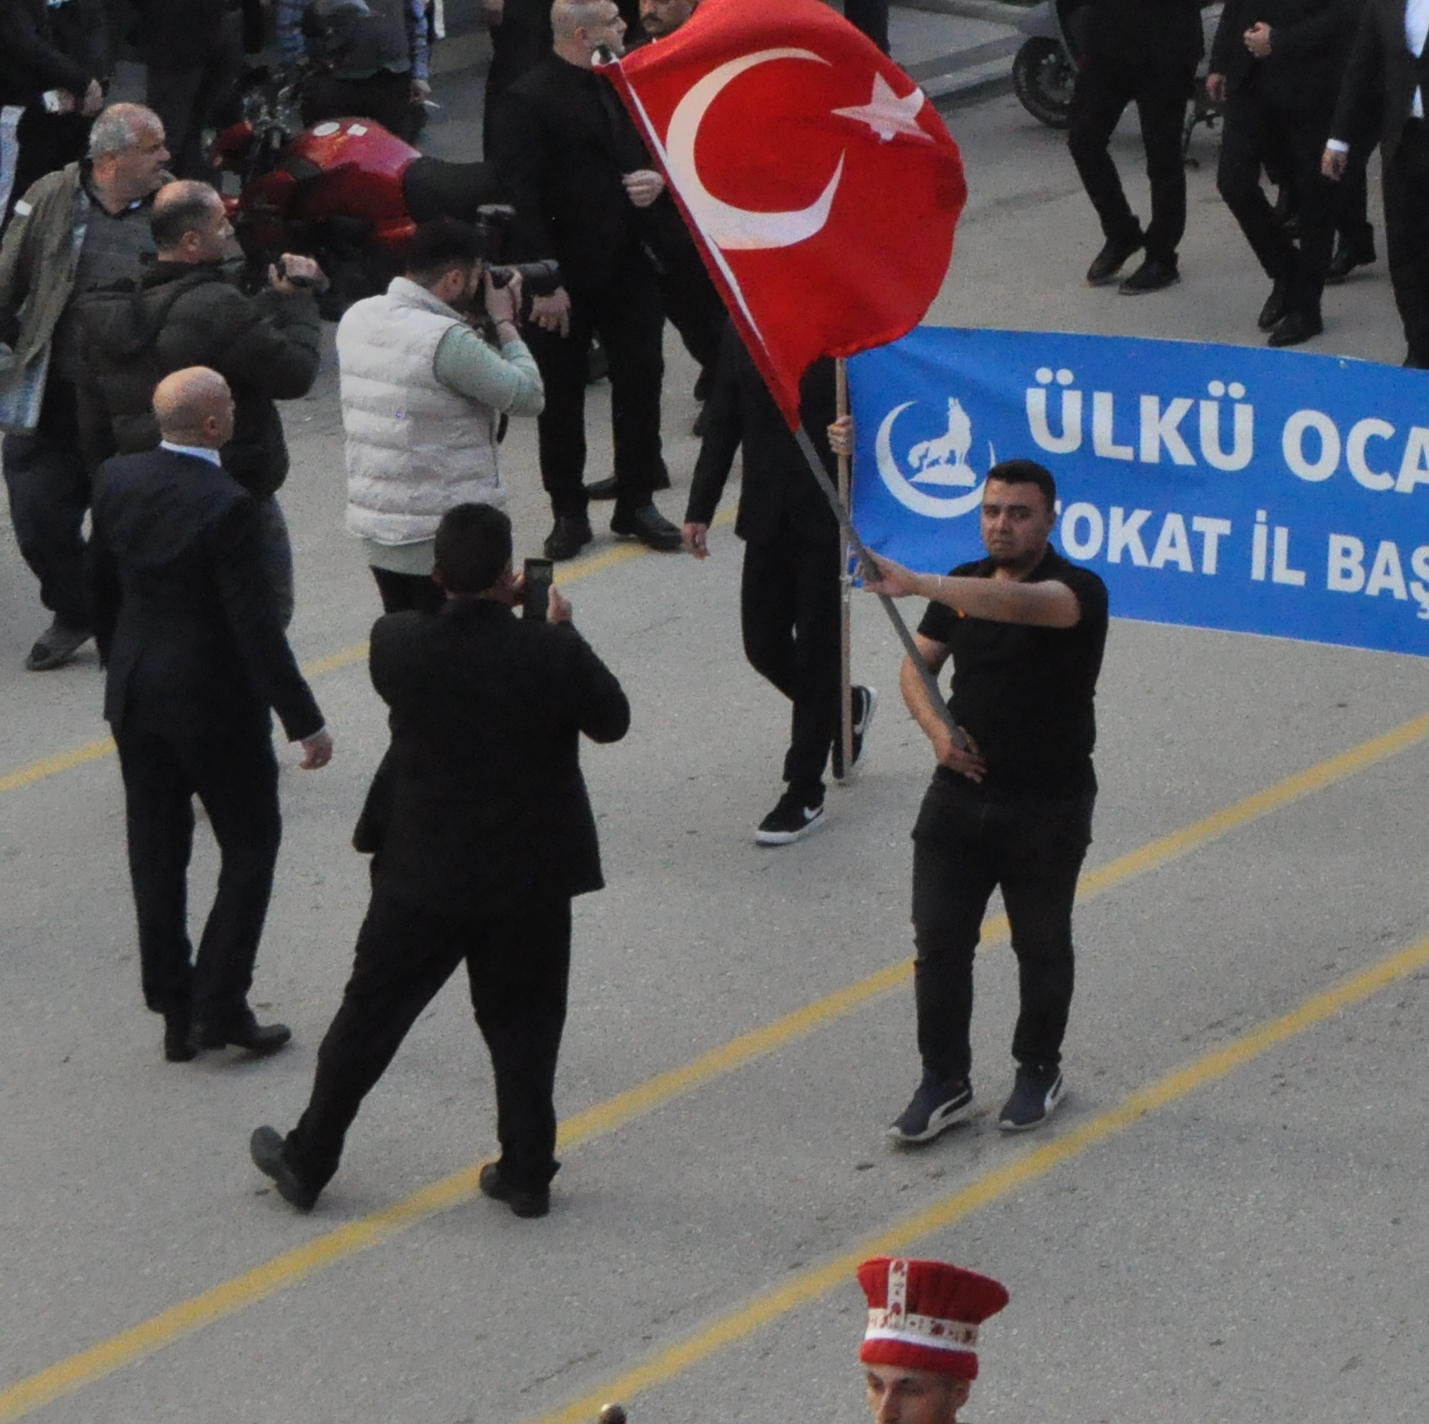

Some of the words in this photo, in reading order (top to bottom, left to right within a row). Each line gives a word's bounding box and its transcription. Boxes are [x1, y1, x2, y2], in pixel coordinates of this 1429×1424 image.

[1025, 366, 1254, 471] ÜLKÜ
[1053, 501, 1231, 576] OKAT
[1252, 511, 1305, 587] İL
